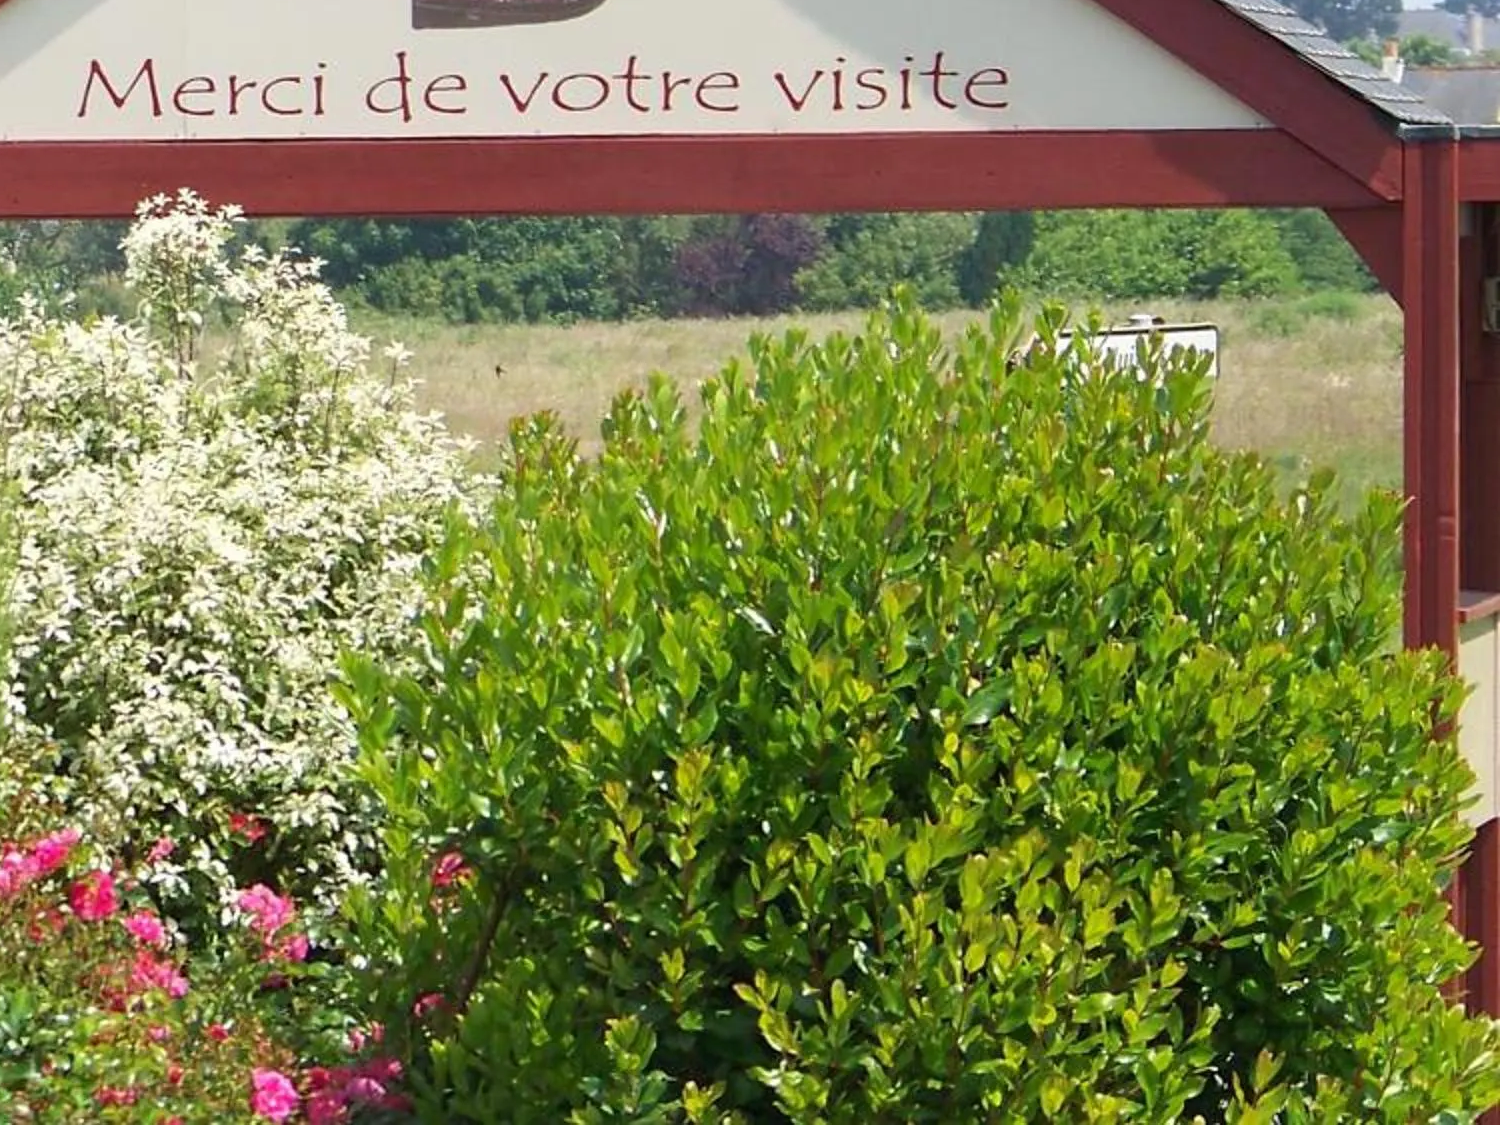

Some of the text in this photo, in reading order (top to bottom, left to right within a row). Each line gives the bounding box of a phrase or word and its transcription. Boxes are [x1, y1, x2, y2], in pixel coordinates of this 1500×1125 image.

[77, 50, 1010, 124] Merci de votre visite
